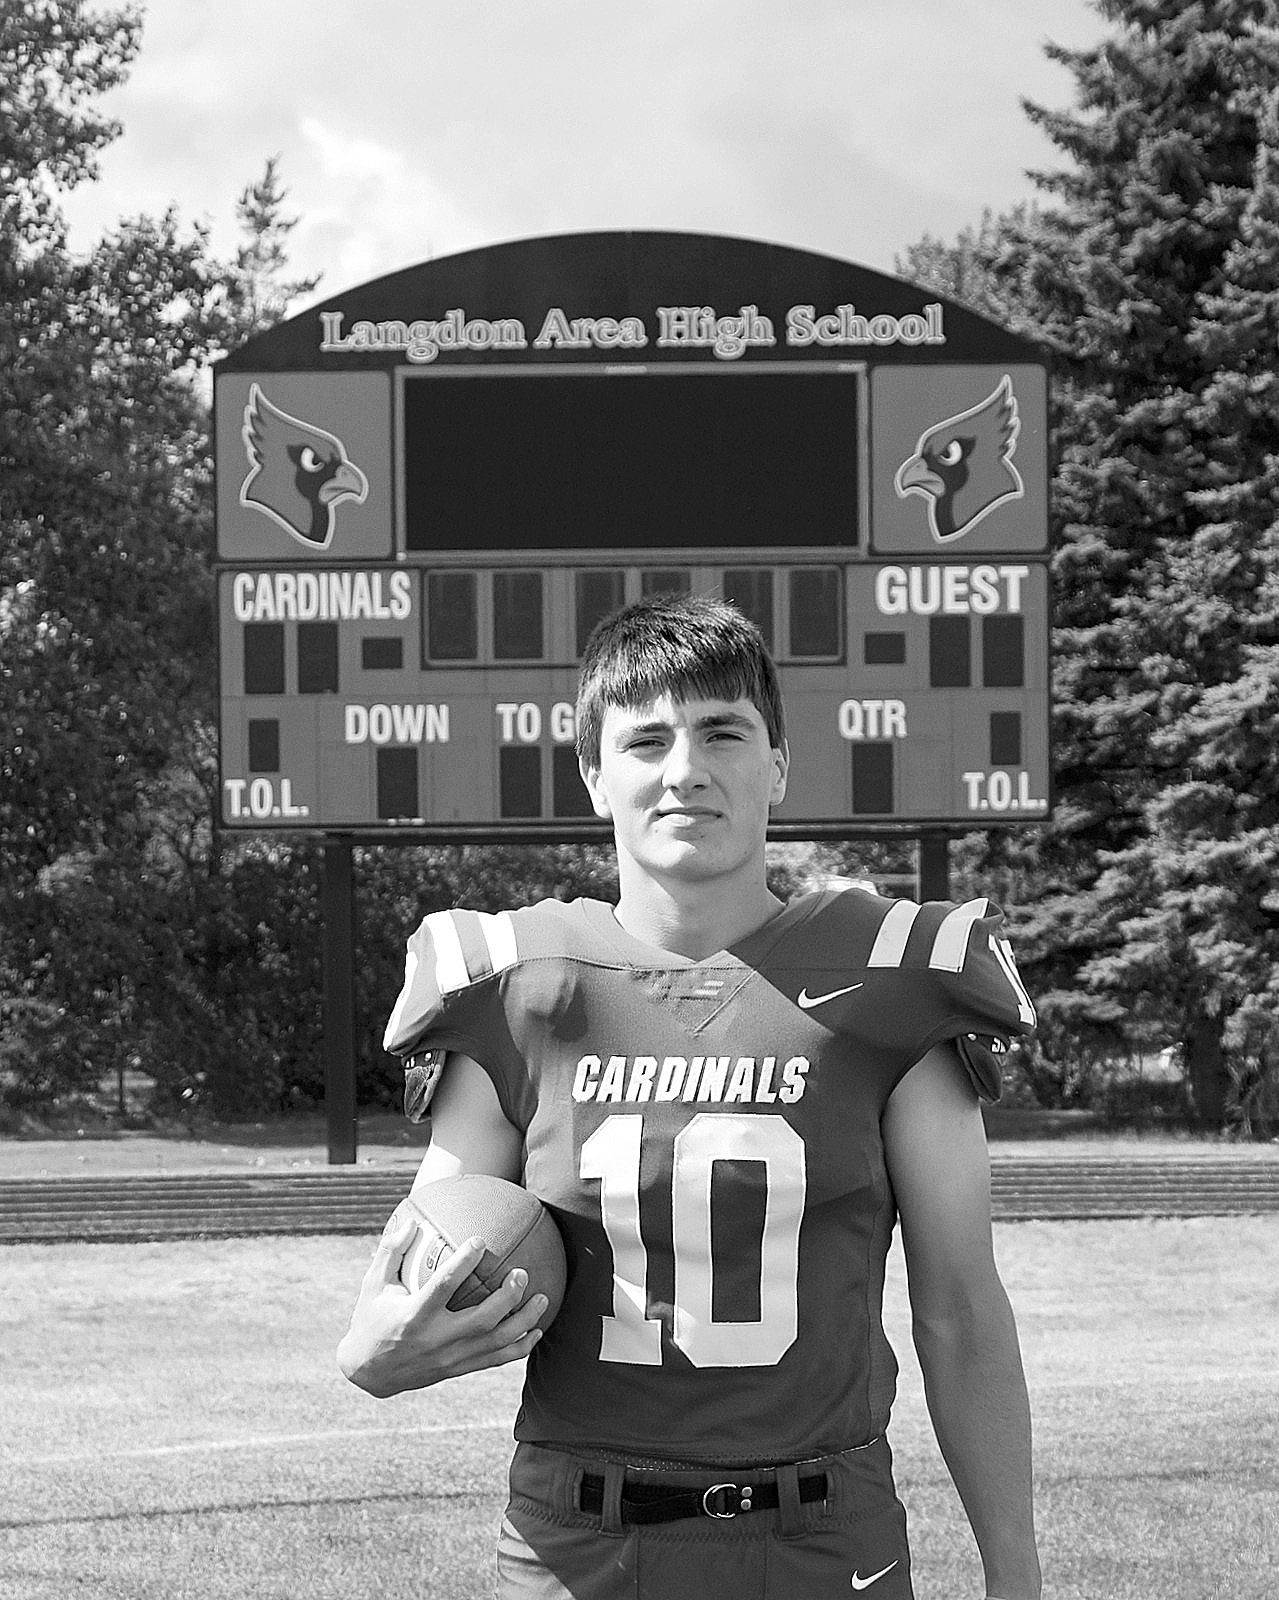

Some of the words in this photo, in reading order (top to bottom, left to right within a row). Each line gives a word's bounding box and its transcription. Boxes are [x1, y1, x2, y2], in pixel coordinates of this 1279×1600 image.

[320, 308, 528, 364] Langdon
[533, 307, 648, 351] Area
[656, 304, 776, 360] High
[786, 303, 946, 346] School
[233, 571, 412, 622] CARDINALS
[875, 564, 1029, 616] GUEST
[344, 703, 450, 744] DOWN
[495, 702, 542, 743] TO
[550, 701, 576, 742] G
[837, 698, 908, 740] QTR
[224, 778, 310, 819] T.O.L.
[961, 770, 1048, 811] T.O.L.
[571, 1054, 810, 1104] CARDINALS
[579, 1112, 807, 1369] 10
